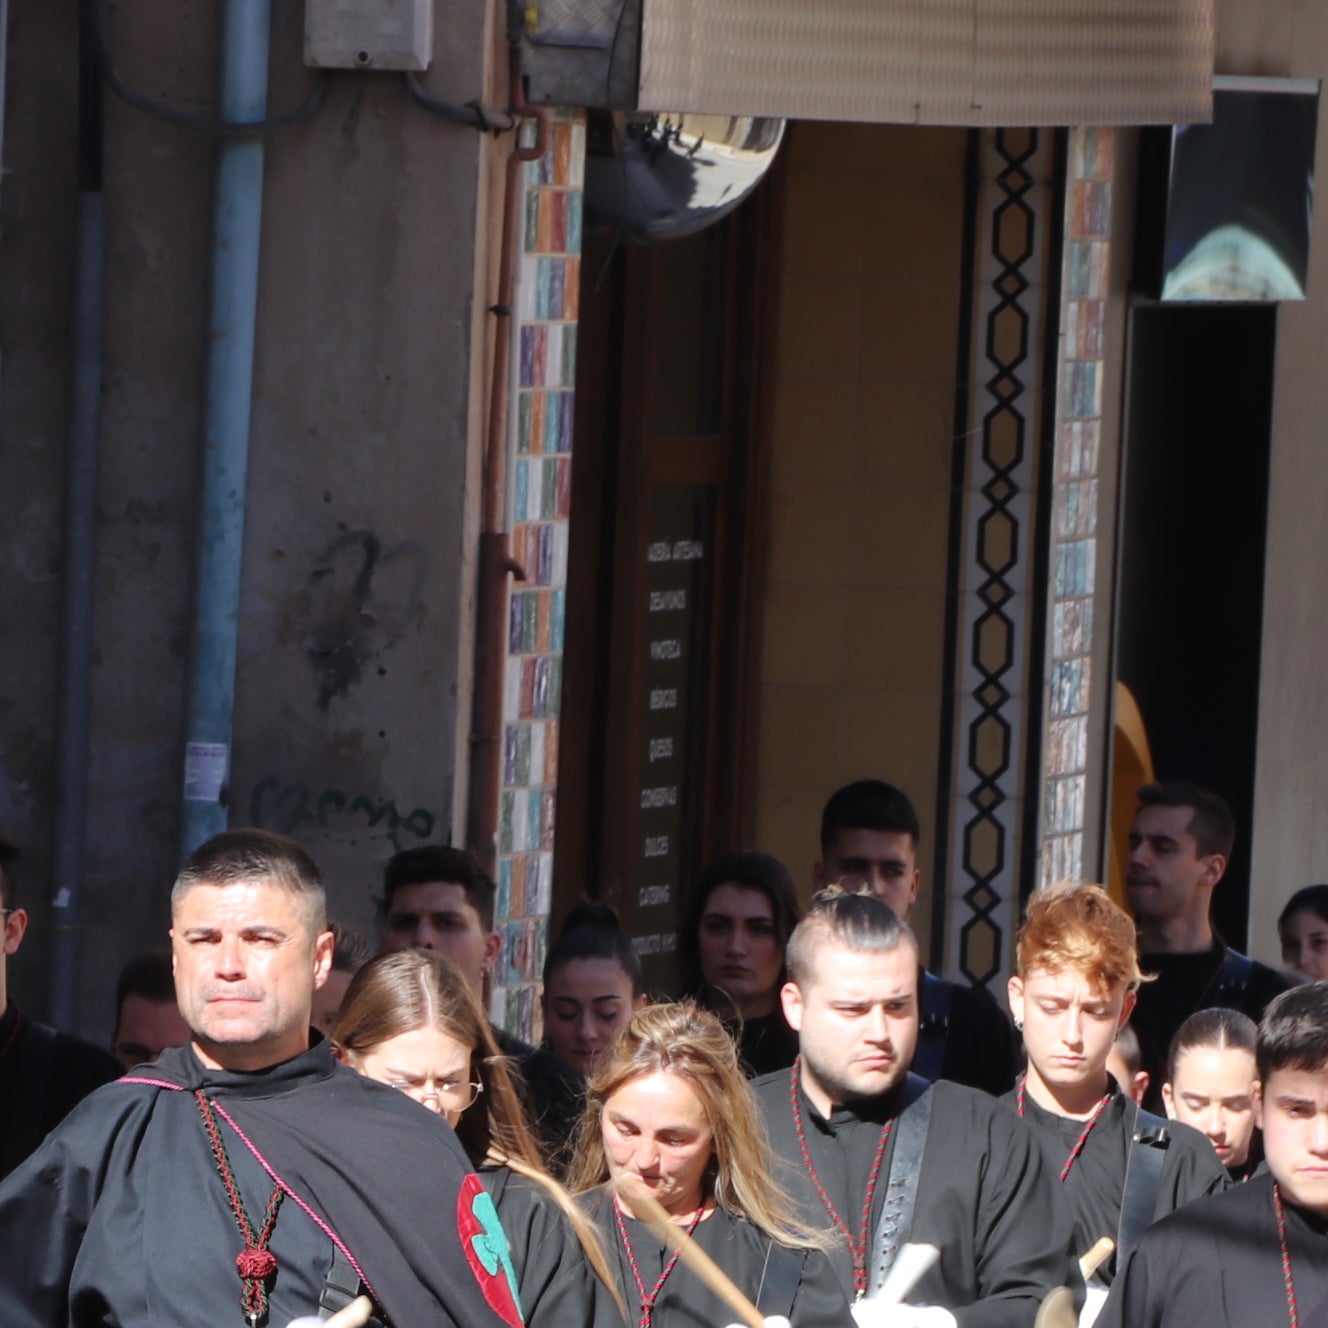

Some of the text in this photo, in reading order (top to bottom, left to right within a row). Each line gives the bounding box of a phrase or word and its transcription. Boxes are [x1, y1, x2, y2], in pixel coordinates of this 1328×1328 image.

[650, 639, 681, 660] VINOTECA
[649, 738, 673, 762] QUESOS
[641, 786, 677, 808] CONSERVAS
[644, 836, 669, 858] DULCES
[639, 884, 670, 906] CATERING
